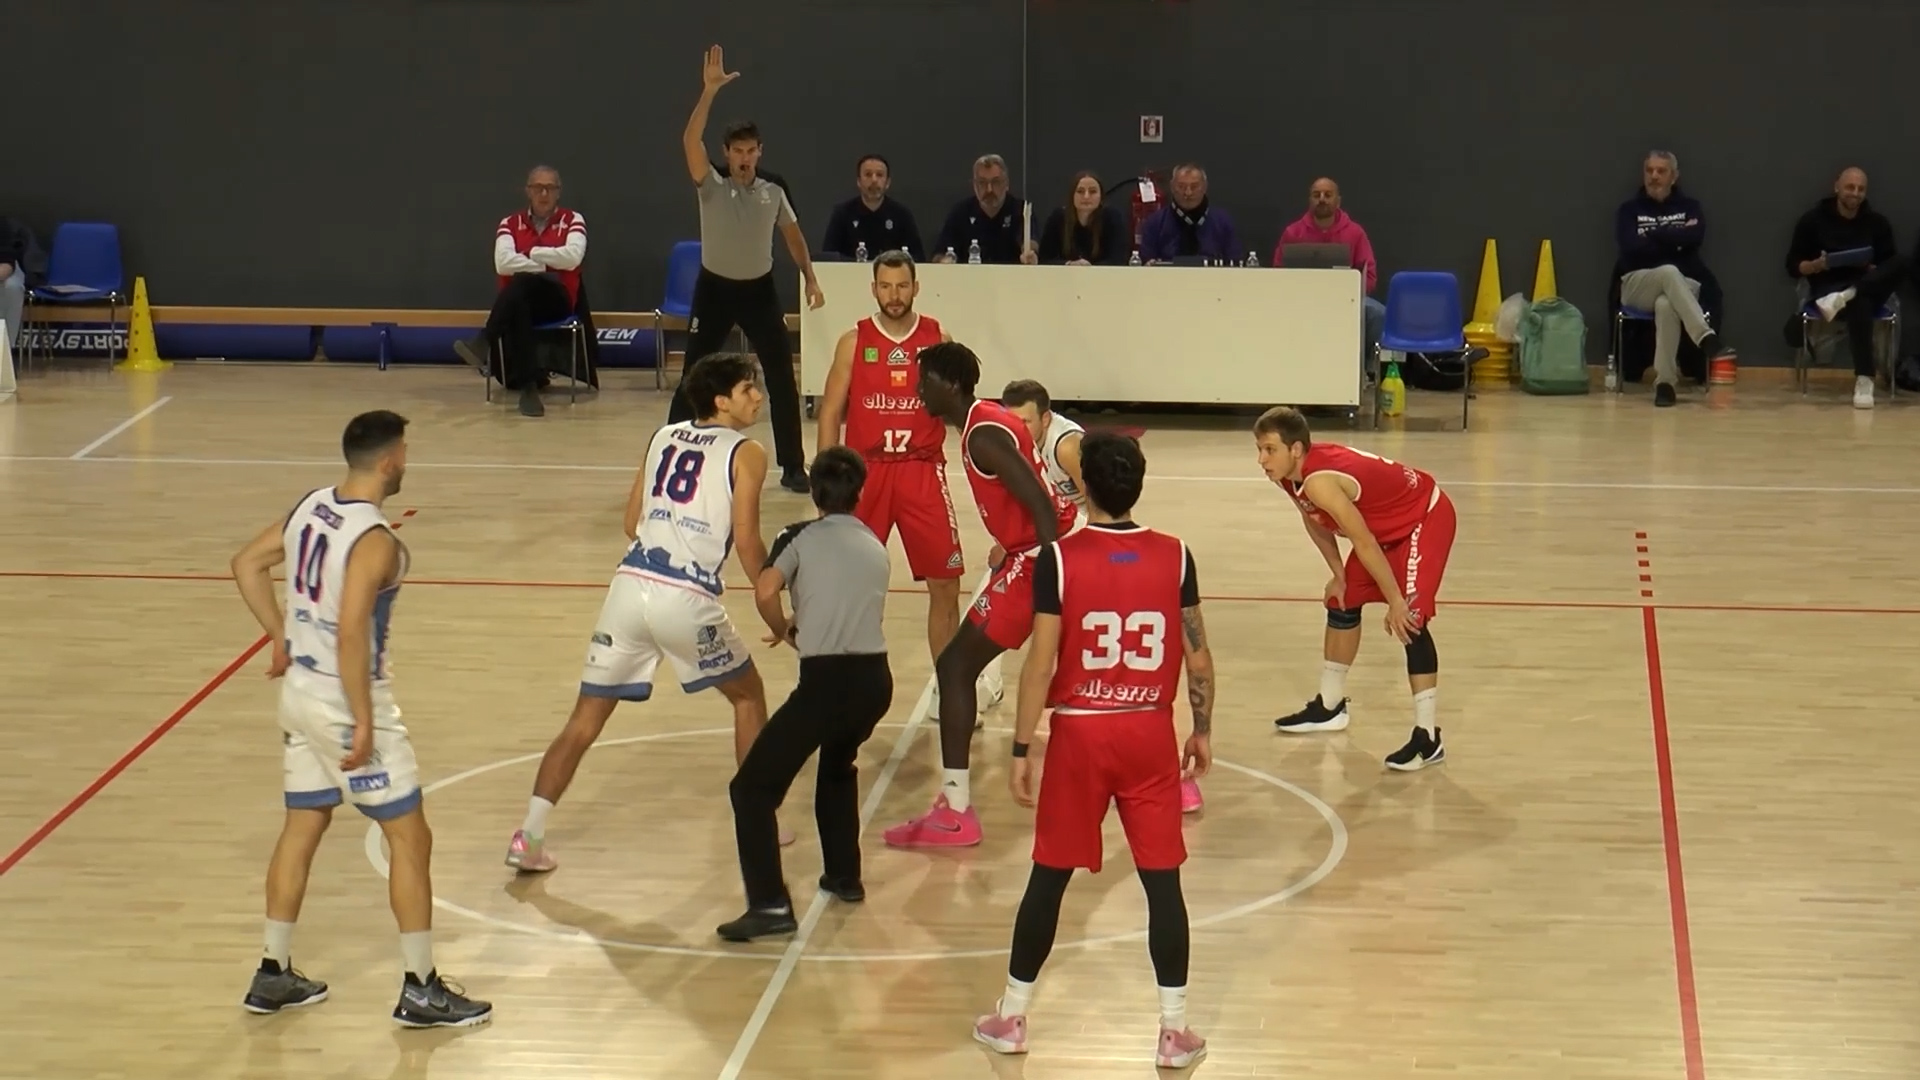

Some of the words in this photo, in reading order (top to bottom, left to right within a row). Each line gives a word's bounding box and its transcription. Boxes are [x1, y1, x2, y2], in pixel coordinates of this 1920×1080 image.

[596, 328, 639, 340] TEM
[862, 392, 926, 410] elleerr
[670, 428, 718, 446] FELAPPI
[883, 429, 912, 453] 17
[651, 443, 706, 505] 18
[295, 523, 329, 603] 10
[1082, 611, 1166, 671] 33
[1073, 679, 1160, 702] elleerre
